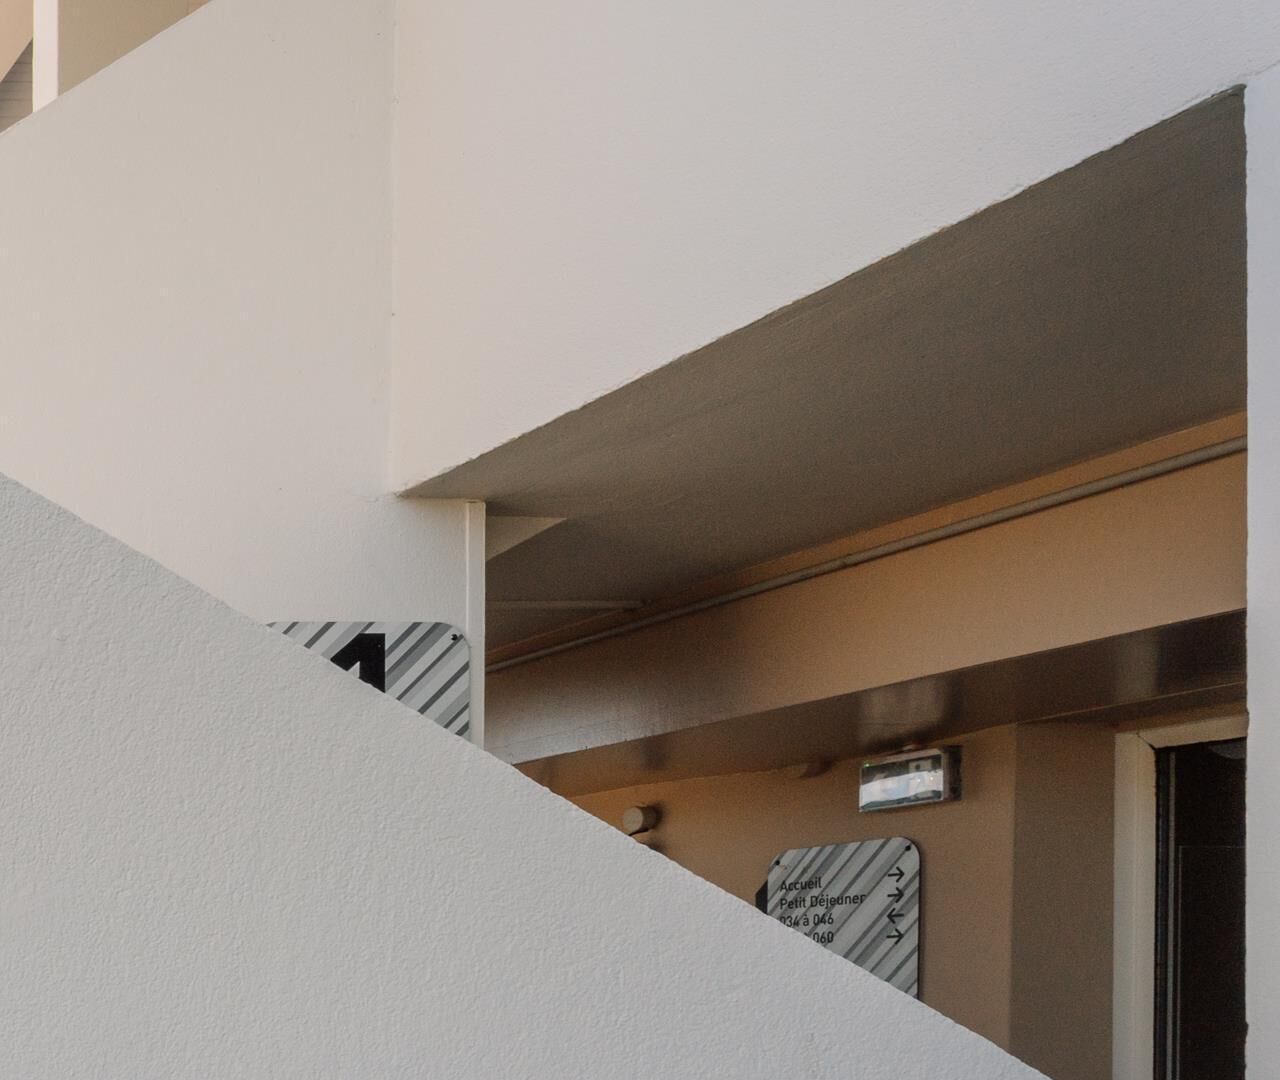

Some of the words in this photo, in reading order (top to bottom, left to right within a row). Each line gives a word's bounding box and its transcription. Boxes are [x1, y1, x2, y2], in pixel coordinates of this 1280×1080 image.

[780, 877, 822, 892] Accueil
[780, 896, 807, 909] Petit
[810, 894, 867, 909] Déjeuner
[803, 914, 809, 927] à
[813, 913, 834, 926] 046
